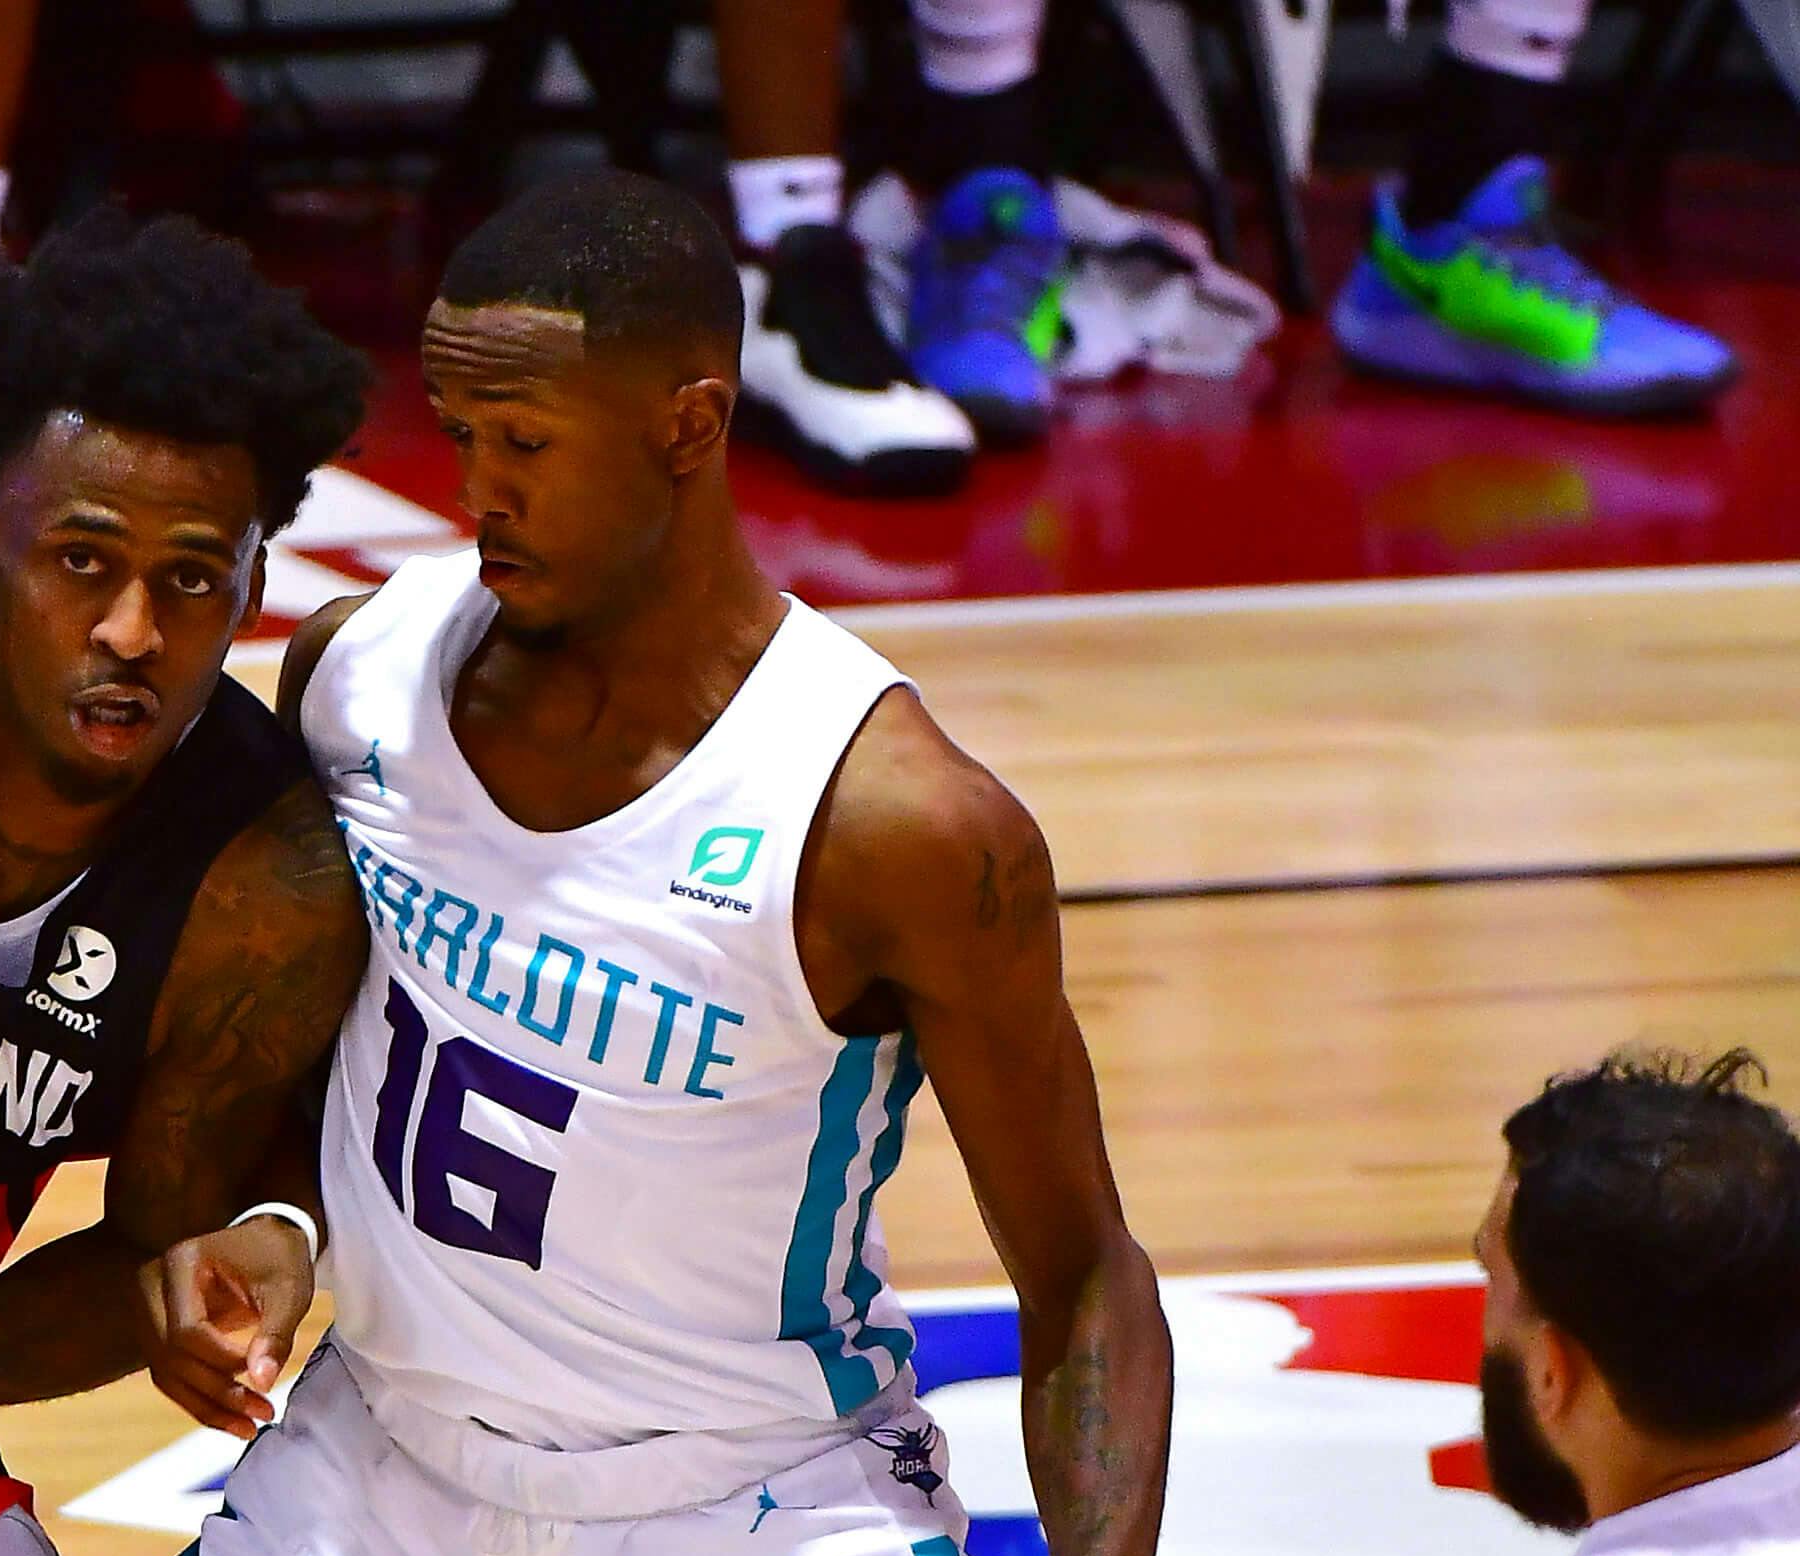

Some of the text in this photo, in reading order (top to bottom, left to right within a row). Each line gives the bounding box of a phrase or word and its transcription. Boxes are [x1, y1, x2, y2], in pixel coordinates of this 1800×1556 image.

[336, 818, 746, 1101] ARLOTTE
[669, 880, 753, 915] lendingtree
[372, 974, 580, 1272] 16
